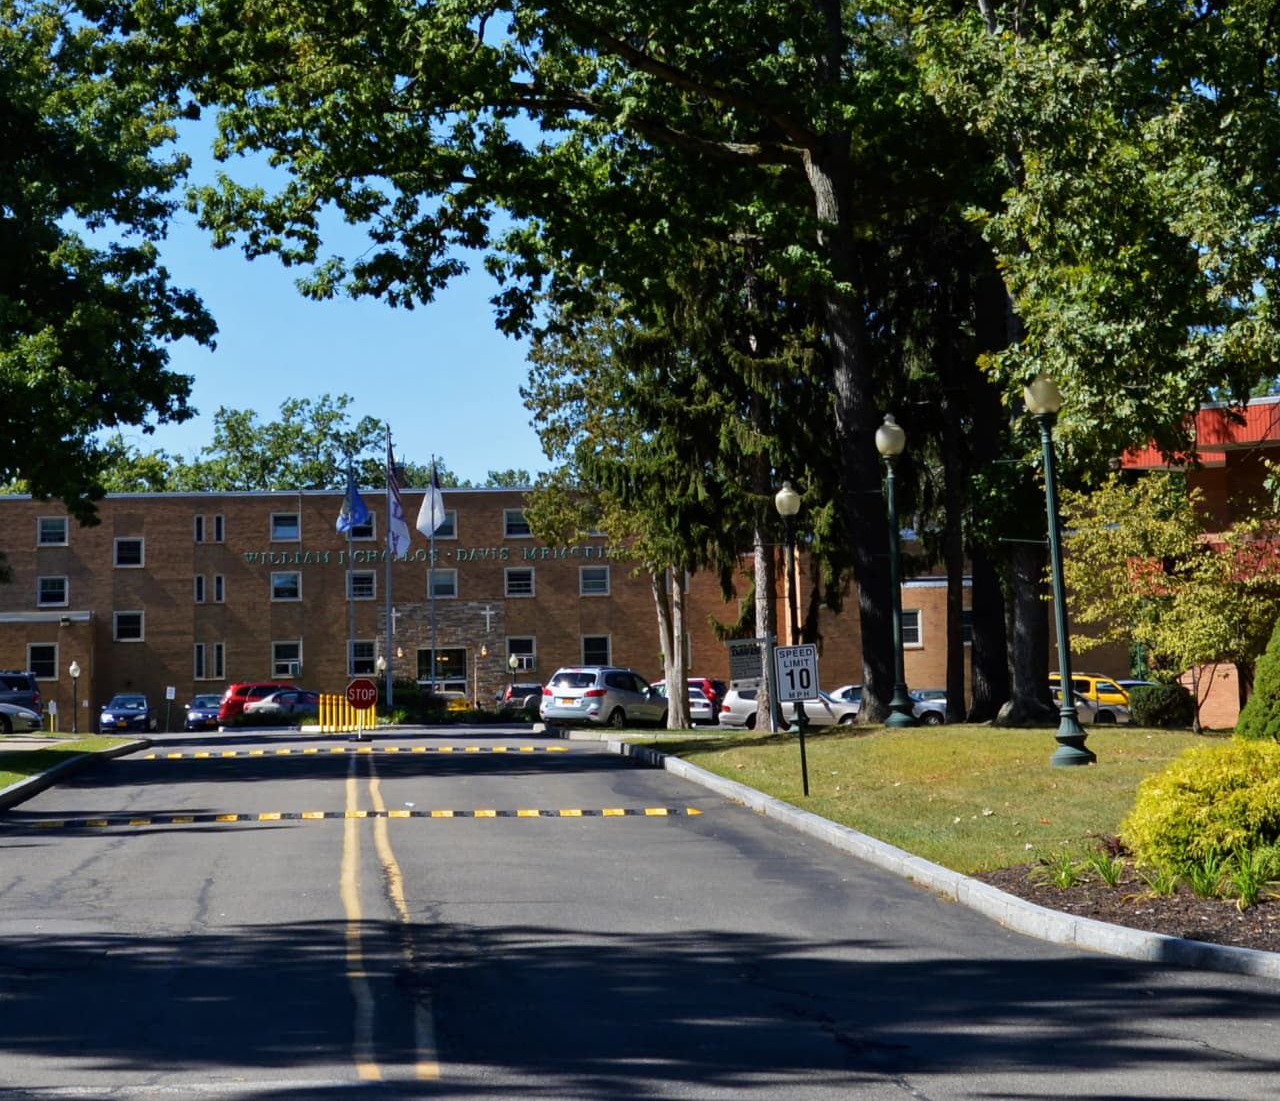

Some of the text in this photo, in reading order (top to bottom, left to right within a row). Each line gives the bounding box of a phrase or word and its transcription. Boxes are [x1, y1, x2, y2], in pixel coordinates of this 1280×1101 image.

[244, 550, 331, 564] WILLIAM
[352, 548, 439, 563] CHALOS
[456, 547, 510, 562] DAVIS
[522, 545, 628, 560] MEMORIA
[778, 649, 812, 658] SPEED
[783, 659, 809, 668] LIMIT
[785, 668, 811, 690] 10
[348, 688, 376, 700] STOP
